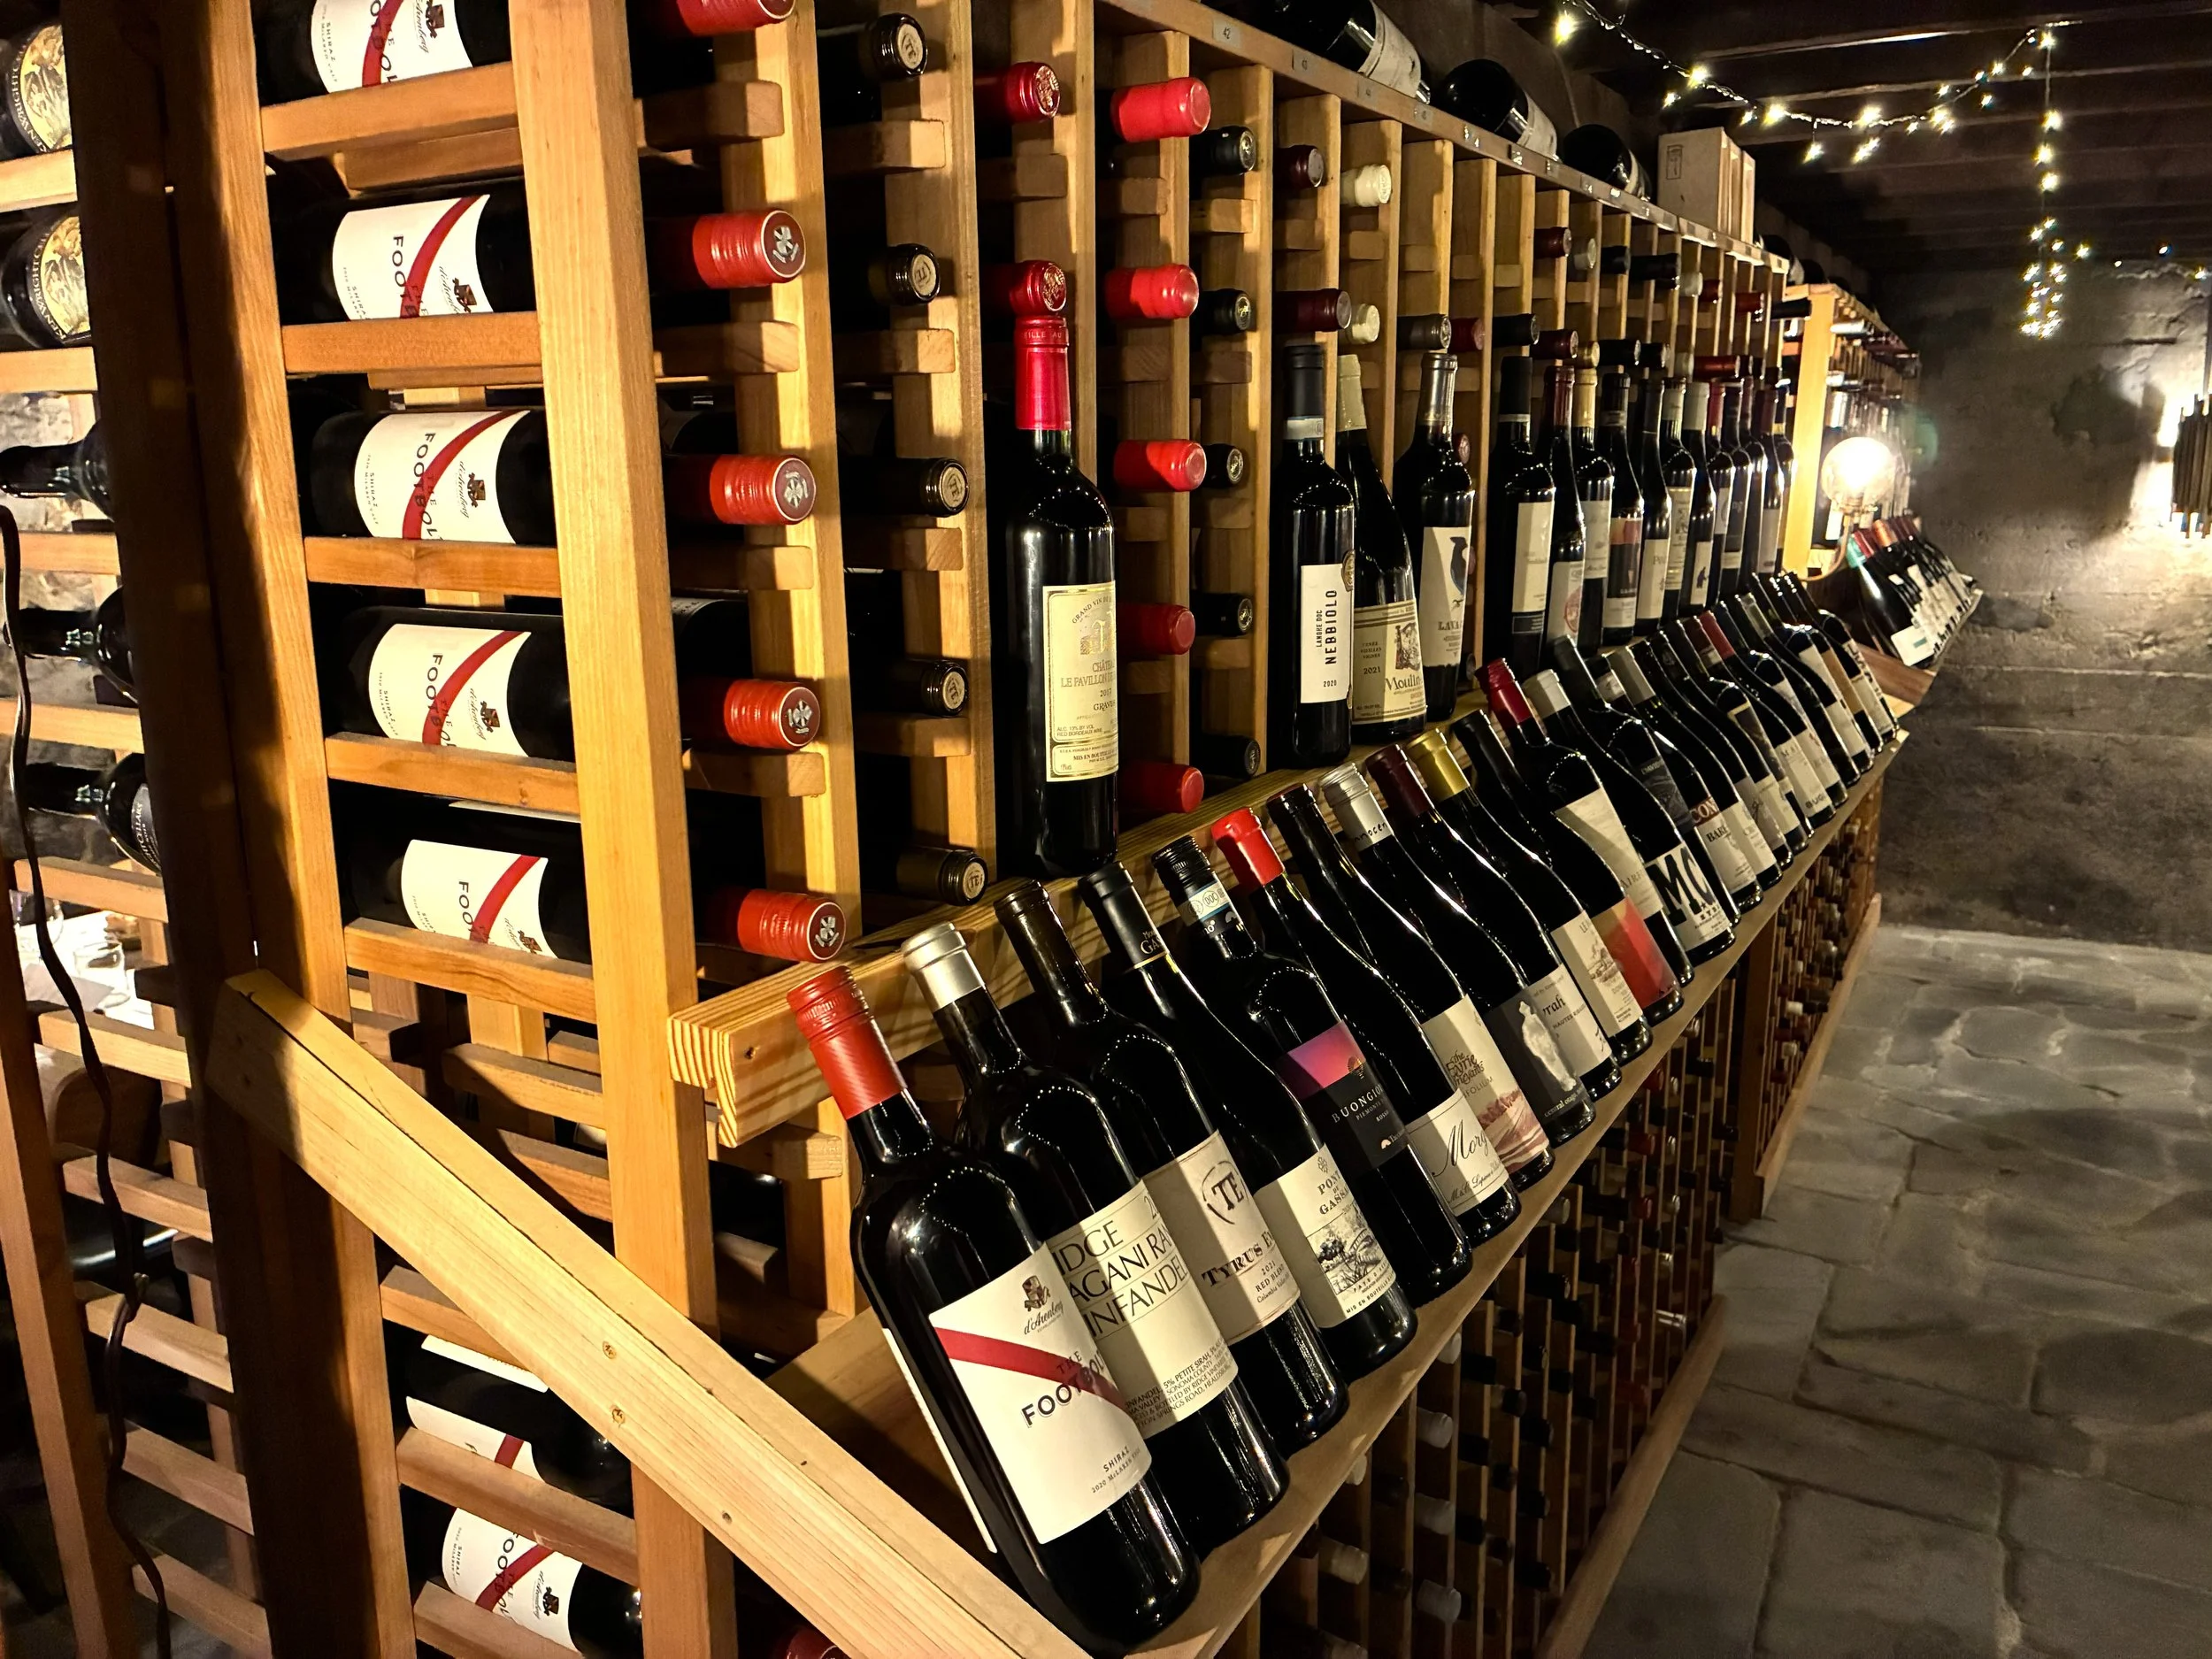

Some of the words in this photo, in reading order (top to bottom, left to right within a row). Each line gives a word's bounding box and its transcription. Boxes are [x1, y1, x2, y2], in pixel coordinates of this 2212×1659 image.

[1325, 589, 1338, 665] NEBBIOLO
[1363, 666, 1380, 675] 2021
[1061, 677, 1072, 687] LE
[1069, 1242, 1149, 1303] AGANI
[1201, 1243, 1263, 1287] TYRUS
[1261, 1260, 1276, 1276] 2021
[1255, 1278, 1271, 1293] RED
[1346, 1304, 1357, 1314] MIS
[1163, 1378, 1176, 1389] 5%
[1174, 1363, 1195, 1382] PETITE
[1139, 1394, 1162, 1410] VALLEY
[1166, 1375, 1194, 1396] SONOMA
[1103, 1445, 1130, 1473] SHIRAZ
[1091, 1479, 1107, 1494] 2020
